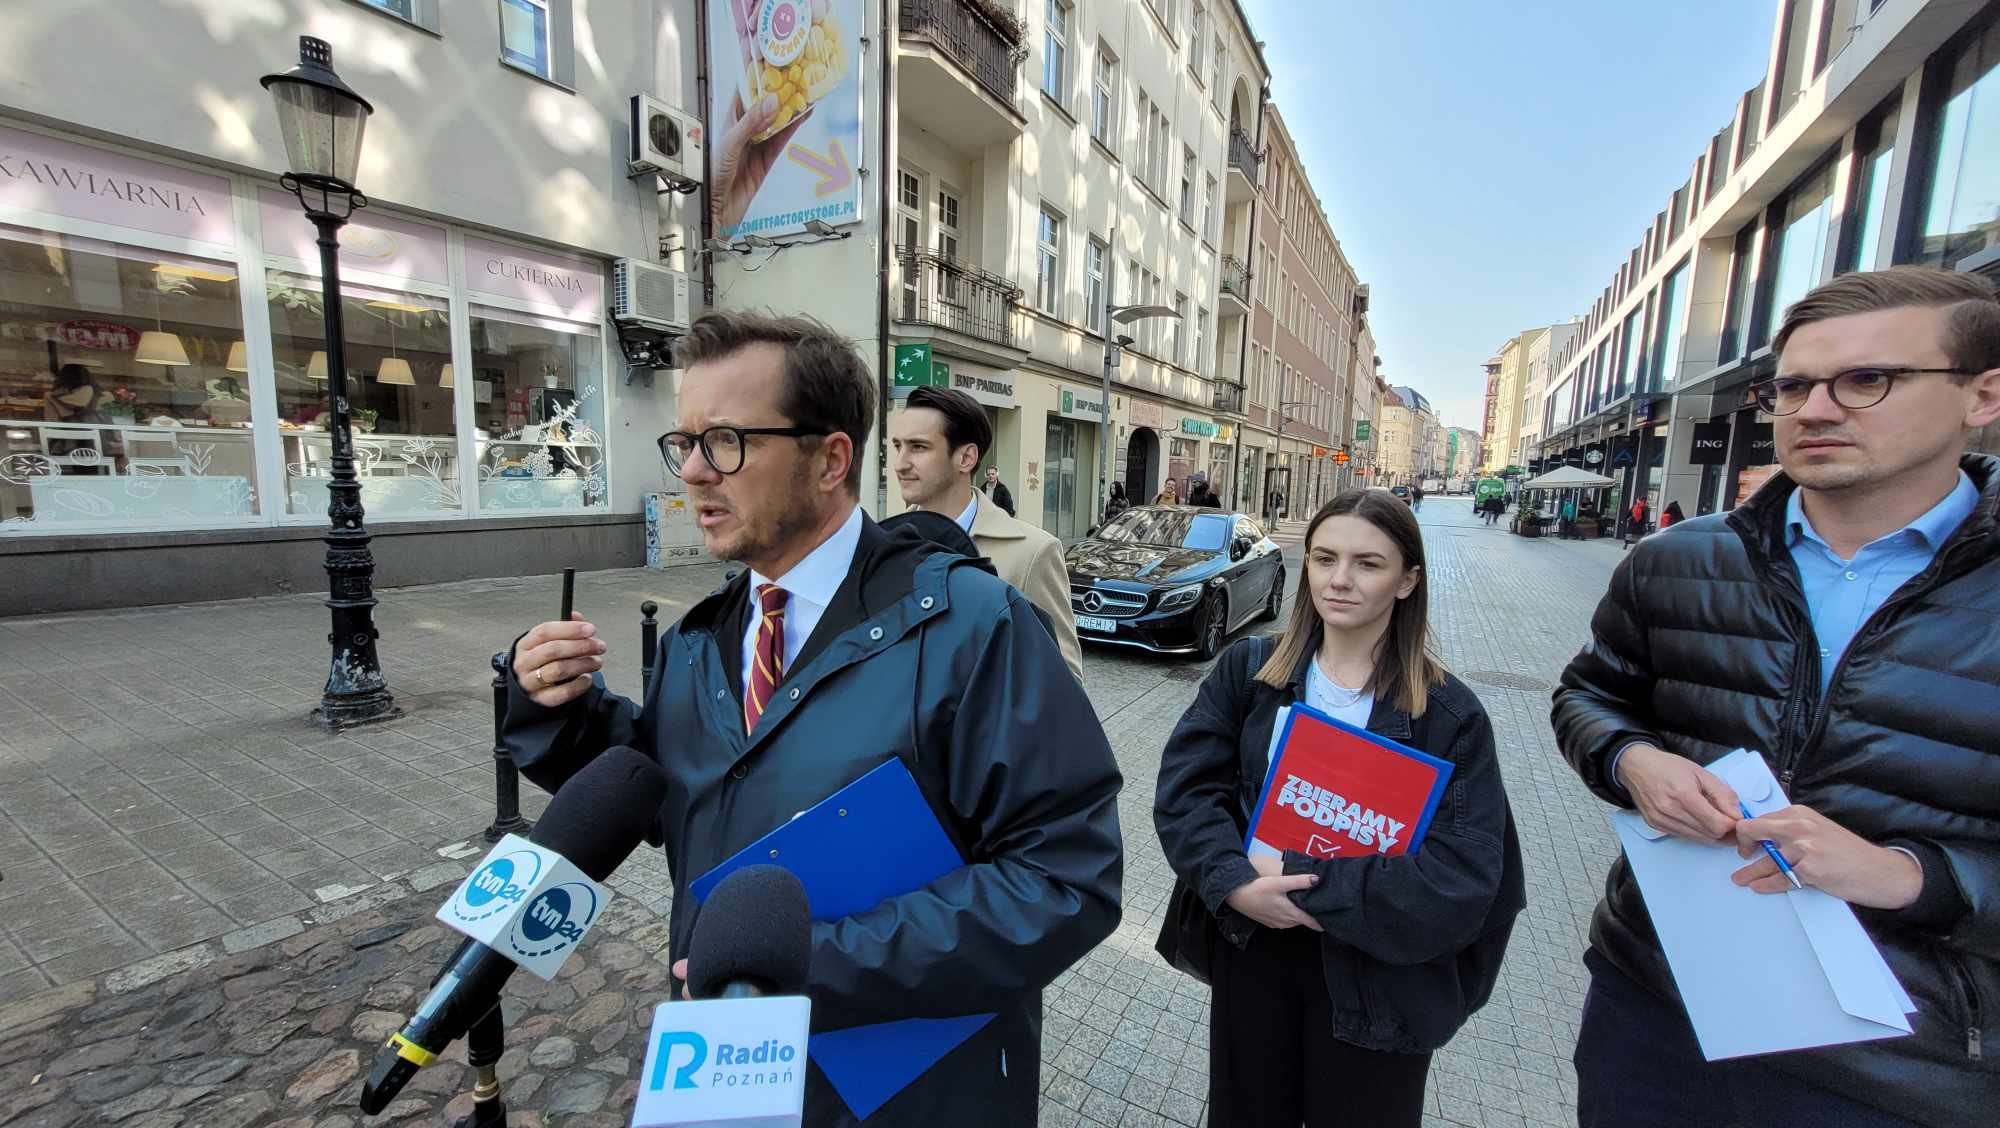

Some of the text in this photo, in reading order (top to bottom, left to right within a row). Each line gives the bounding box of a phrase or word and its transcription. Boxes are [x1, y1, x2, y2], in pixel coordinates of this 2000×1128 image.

[486, 259, 583, 293] CUKIERNIA
[955, 373, 1014, 397] BNP PARIBAS
[1696, 440, 1723, 448] ING
[1276, 786, 1399, 854] PODPISY
[1287, 774, 1406, 838] ZBIERAMY
[716, 1039, 796, 1067] Radio
[712, 1067, 794, 1089] Poznań
